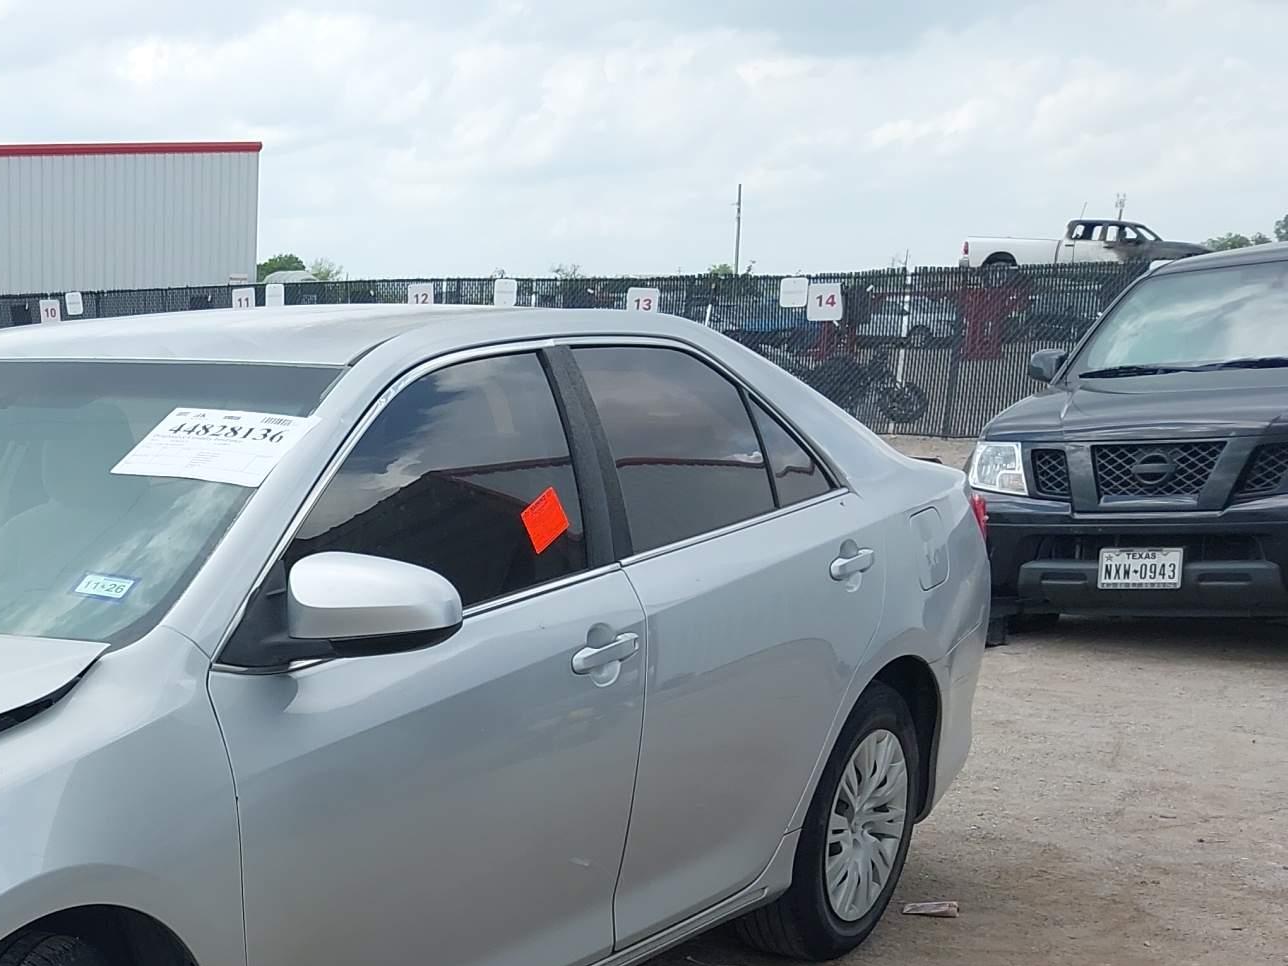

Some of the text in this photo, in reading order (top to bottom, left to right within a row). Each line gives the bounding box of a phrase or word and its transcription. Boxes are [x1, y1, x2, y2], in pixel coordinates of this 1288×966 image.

[238, 297, 249, 308] 11
[414, 293, 429, 304] 12
[816, 294, 836, 307] 14
[634, 298, 652, 311] 13
[44, 308, 57, 318] 10
[168, 422, 287, 443] 44828136
[1126, 552, 1157, 560] TEXAS
